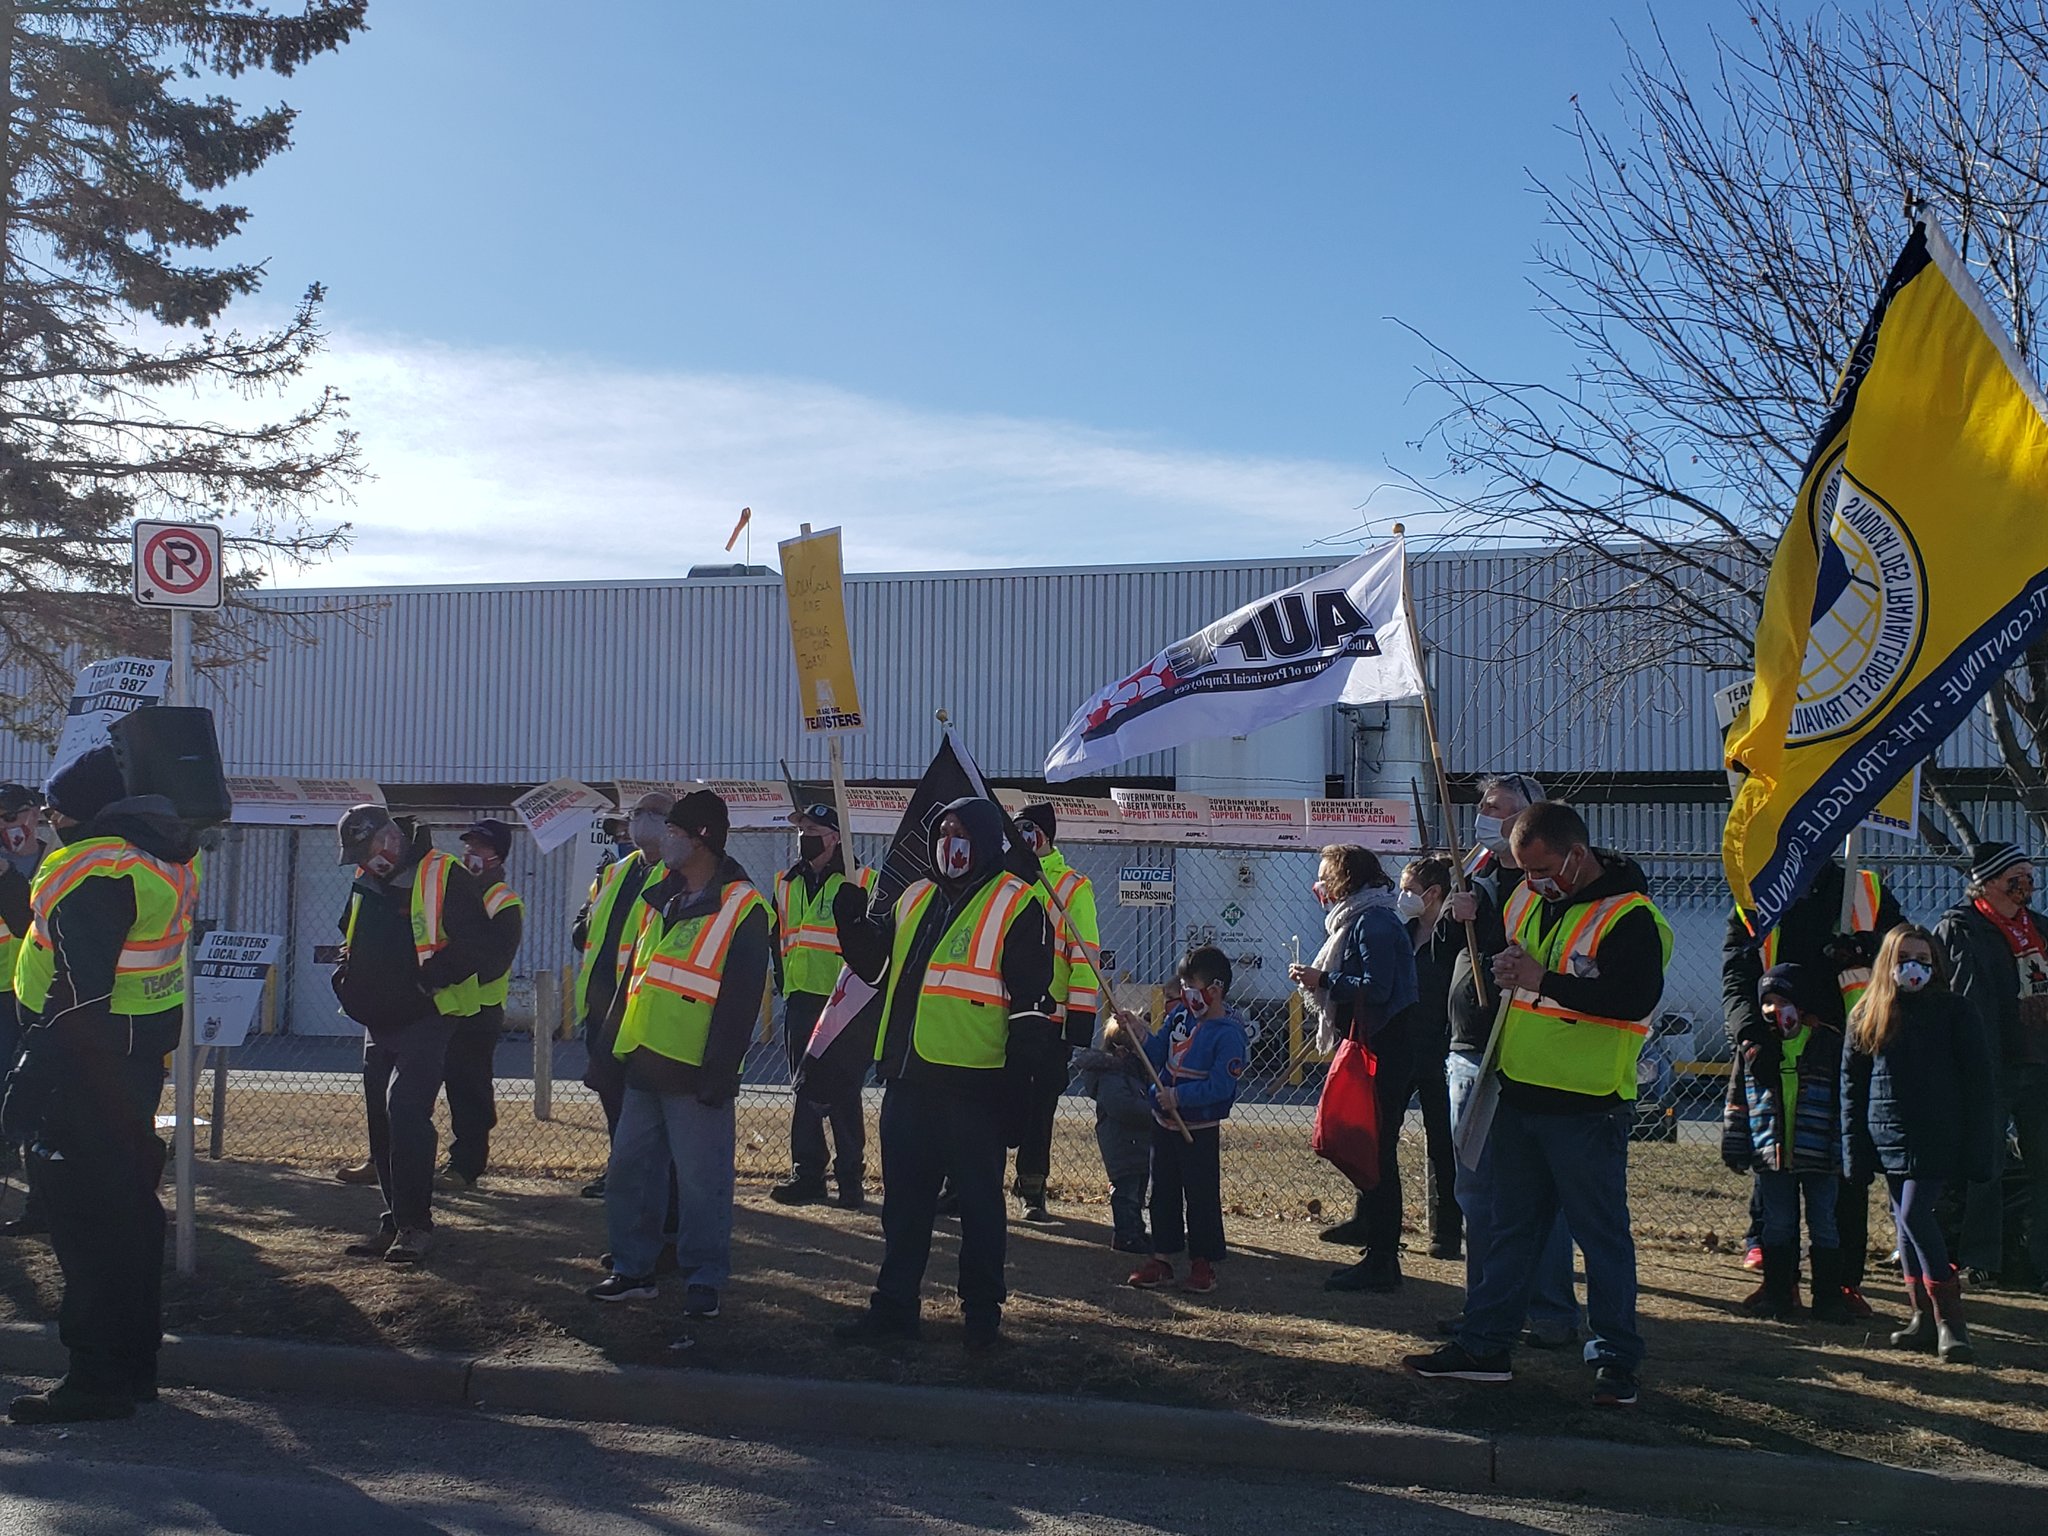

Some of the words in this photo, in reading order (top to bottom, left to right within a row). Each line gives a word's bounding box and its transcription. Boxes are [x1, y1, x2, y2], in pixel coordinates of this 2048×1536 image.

[119, 677, 148, 693] 987
[805, 713, 861, 730] TEAMSTERS
[759, 793, 783, 801] ACTION
[1028, 794, 1075, 803] GOVERNMENT
[1116, 792, 1165, 802] GOVERNMENT
[1166, 794, 1176, 802] OF
[1208, 798, 1258, 806] GOVERNMENT
[848, 800, 879, 808] SUPPORT
[881, 801, 896, 809] THIS
[1062, 802, 1097, 810] WORKERS
[1118, 801, 1149, 811] ALBERTA
[1151, 802, 1187, 811] WORKERS
[1120, 809, 1151, 820] SUPPORT
[1153, 810, 1169, 819] THIS
[1171, 811, 1199, 819] ACTION
[1210, 811, 1243, 819] SUPPORT
[1245, 812, 1263, 820] THIS
[1264, 813, 1292, 821] ACTION
[1347, 807, 1384, 815] WORKERS
[1311, 813, 1346, 822] SUPPORT
[1348, 814, 1366, 823] THIS
[1367, 815, 1396, 824] ACTION
[1122, 870, 1170, 881] NOTICE
[1141, 881, 1152, 890] NO
[1120, 890, 1172, 900] TRESPASSING
[211, 935, 269, 949] TEAMSTERS
[207, 948, 238, 960] LOCAL
[241, 951, 262, 961] 987
[201, 964, 218, 975] ON
[220, 965, 259, 977] STRIKE
